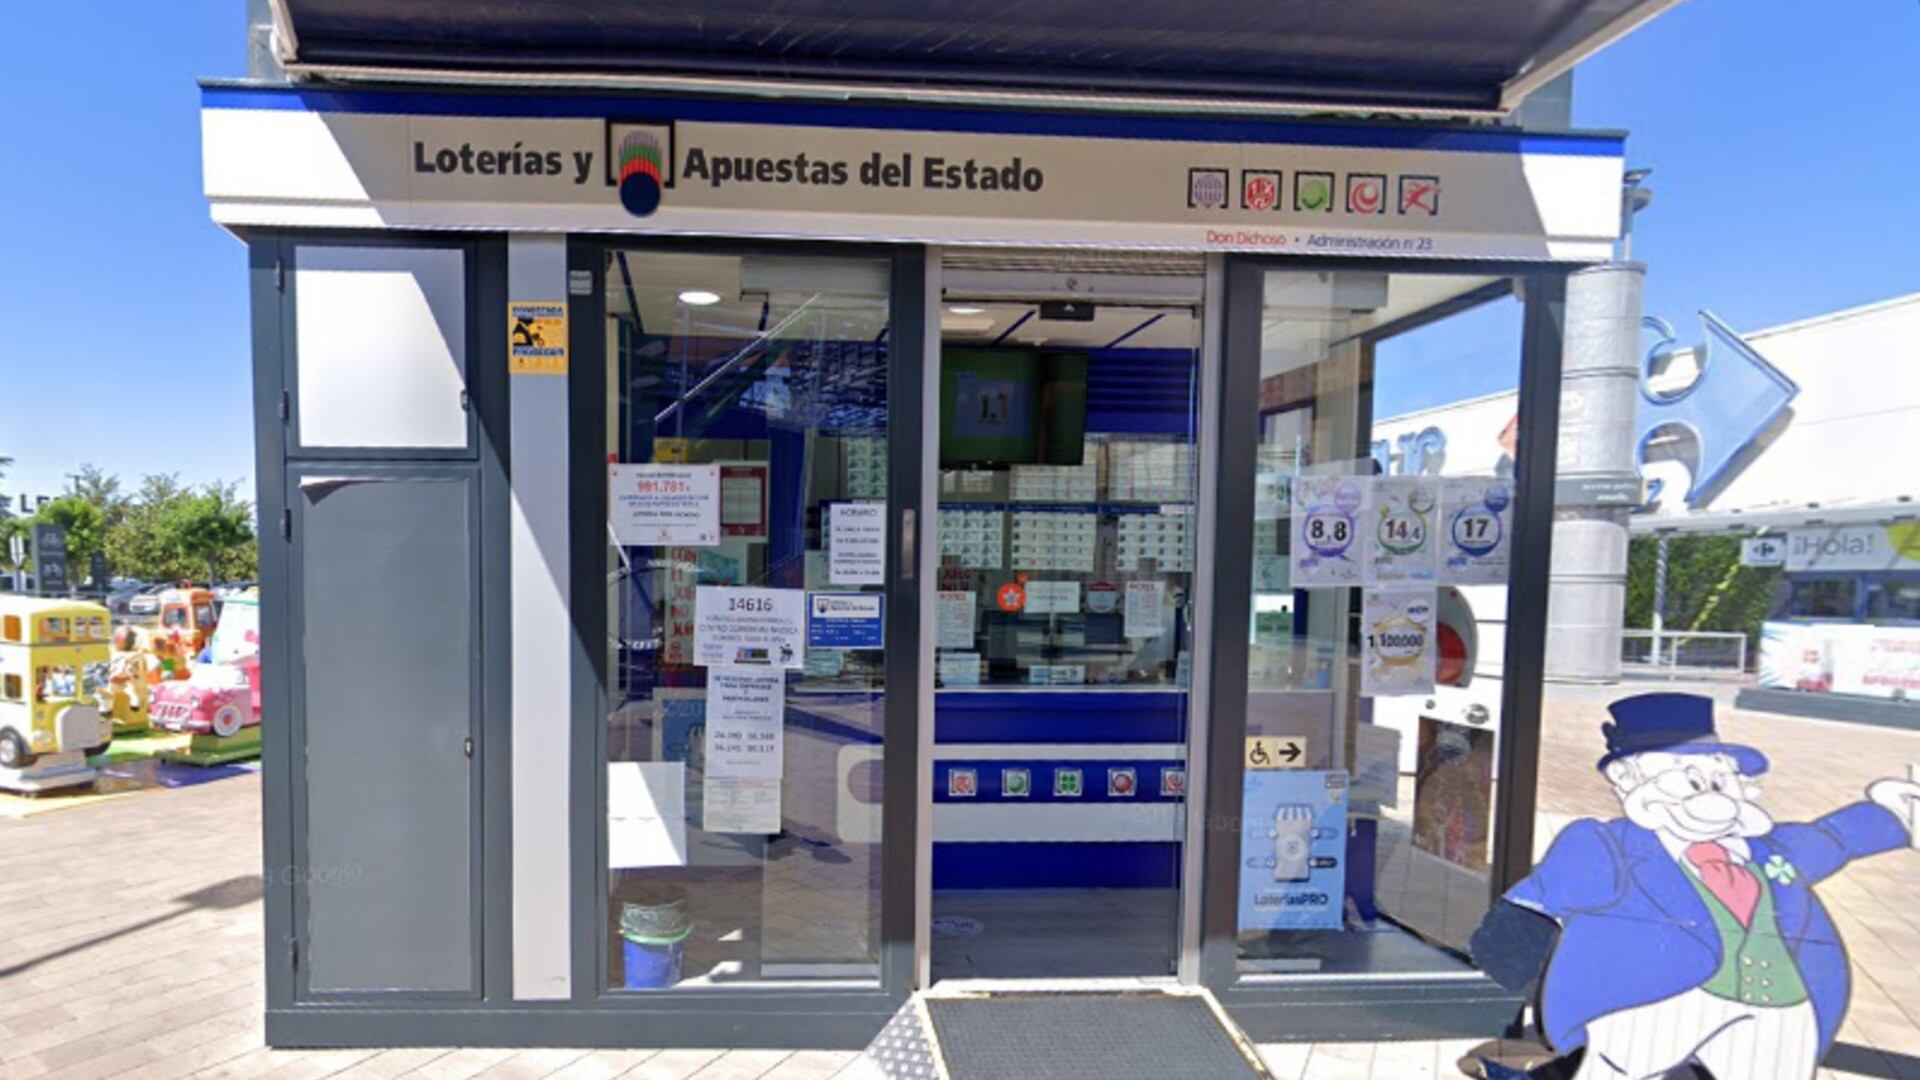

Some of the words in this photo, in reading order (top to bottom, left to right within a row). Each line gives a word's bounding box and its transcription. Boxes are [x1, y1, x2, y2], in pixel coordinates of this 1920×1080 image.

[414, 141, 562, 176] Loterías
[573, 149, 593, 184] y
[683, 147, 848, 187] Apuestas
[860, 153, 911, 187] del
[924, 156, 1043, 192] Estado
[1206, 230, 1234, 244] Don
[1236, 231, 1287, 246] Dichoso
[1306, 232, 1400, 249] Administración
[1416, 237, 1432, 249] 23
[1464, 518, 1489, 538] 17
[1793, 533, 1874, 556] ¡Hola!
[728, 598, 773, 612] 14616
